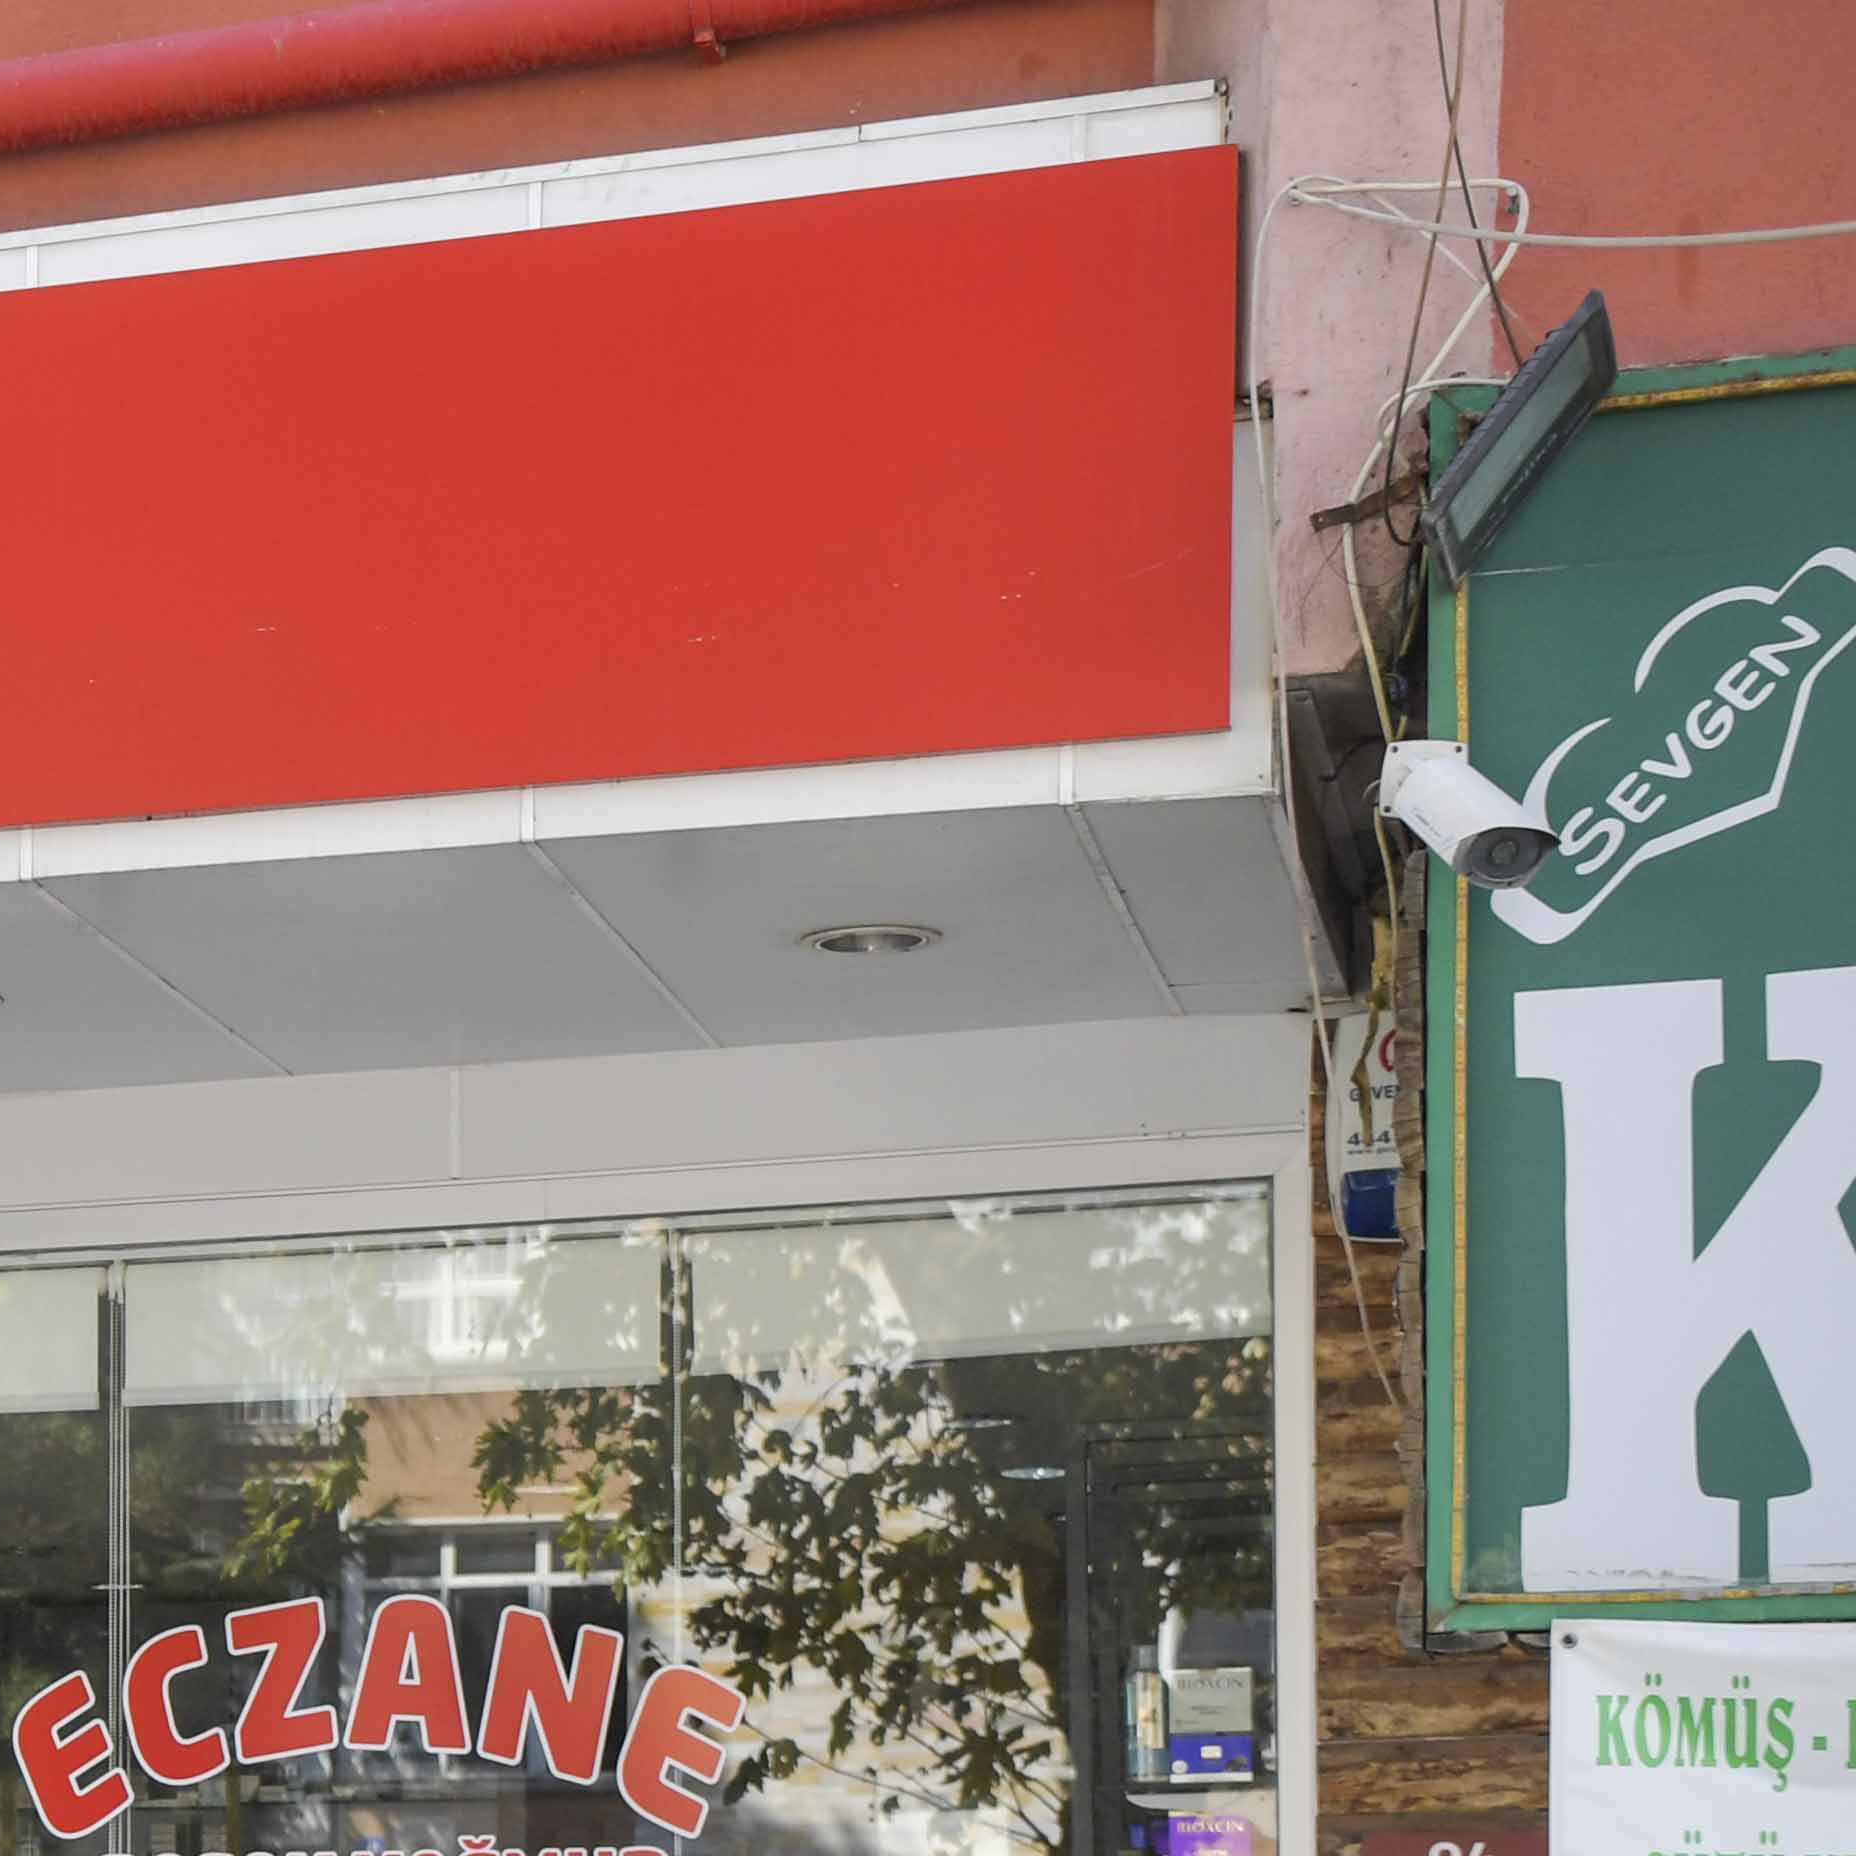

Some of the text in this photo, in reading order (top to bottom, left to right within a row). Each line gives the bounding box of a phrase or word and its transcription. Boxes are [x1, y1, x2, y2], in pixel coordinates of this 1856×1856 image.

[1558, 615, 1822, 876] SEVGEN
[13, 1593, 748, 1840] ECZANE
[1596, 1673, 1795, 1792] KÖMÜŞ
